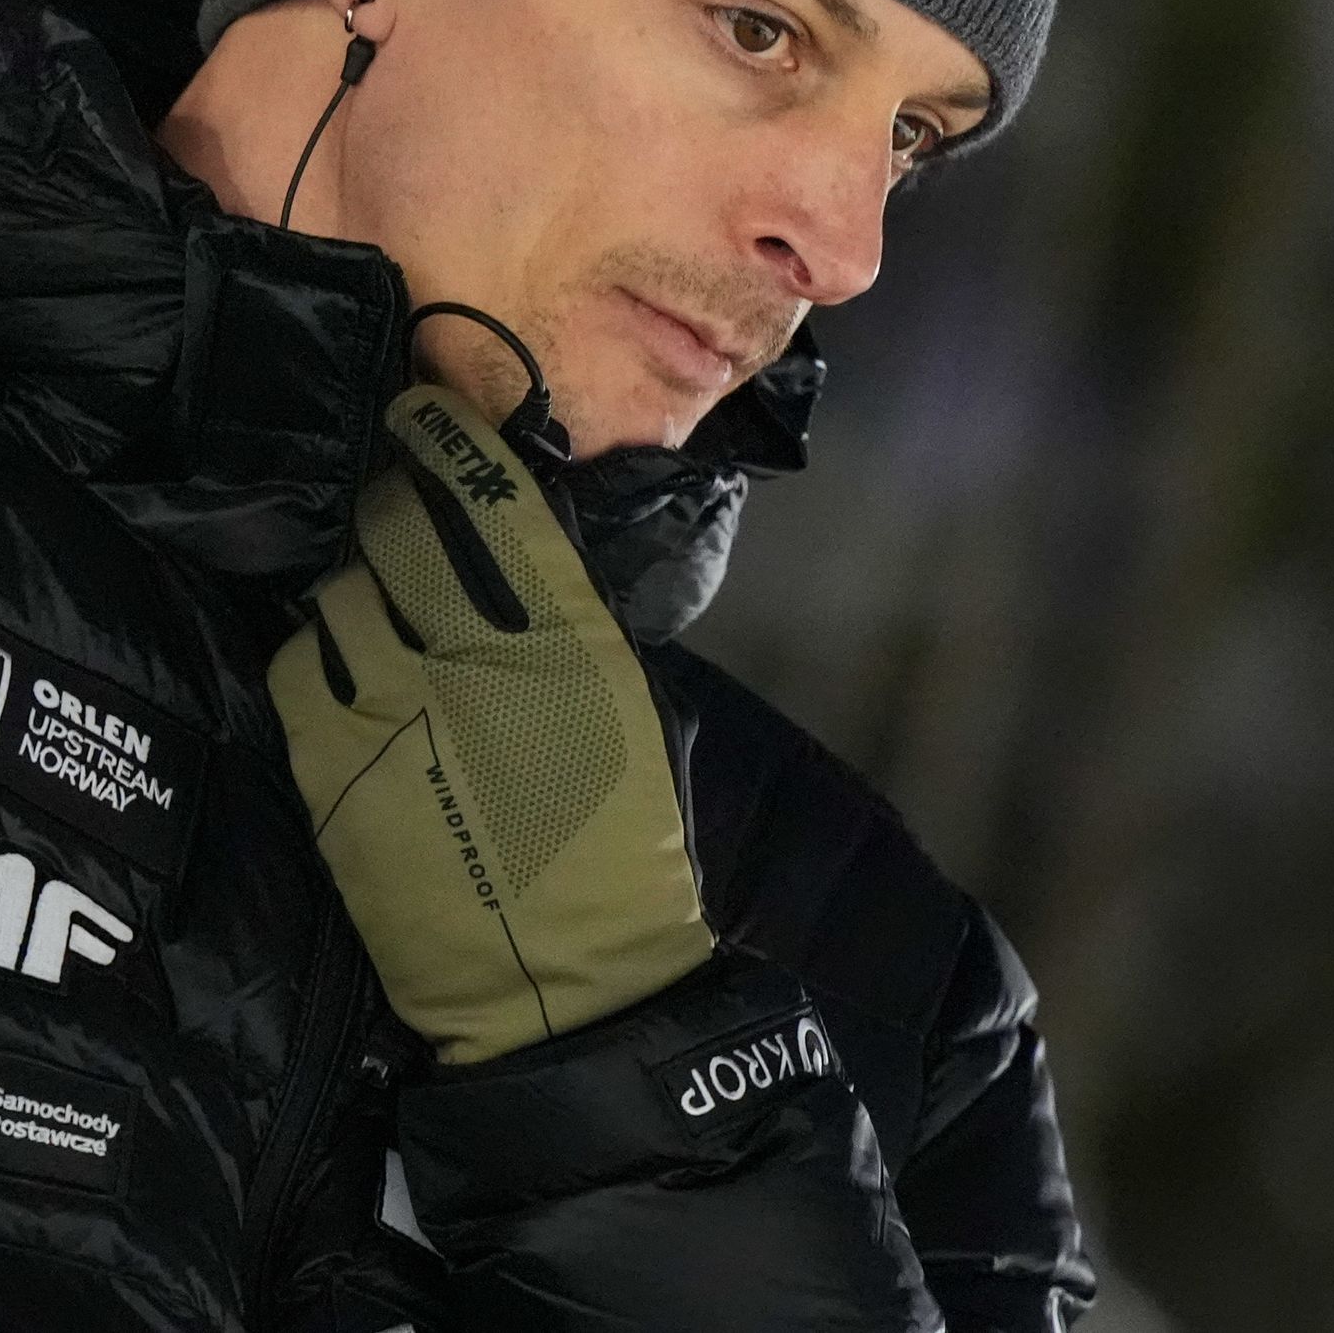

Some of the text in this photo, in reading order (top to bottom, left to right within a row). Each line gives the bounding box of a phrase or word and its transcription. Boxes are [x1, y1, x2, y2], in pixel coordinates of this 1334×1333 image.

[28, 707, 174, 811] UPSTREAM
[33, 679, 152, 764] ORLEN
[18, 732, 137, 813] NORWAY
[426, 764, 501, 911] WINDPROOF
